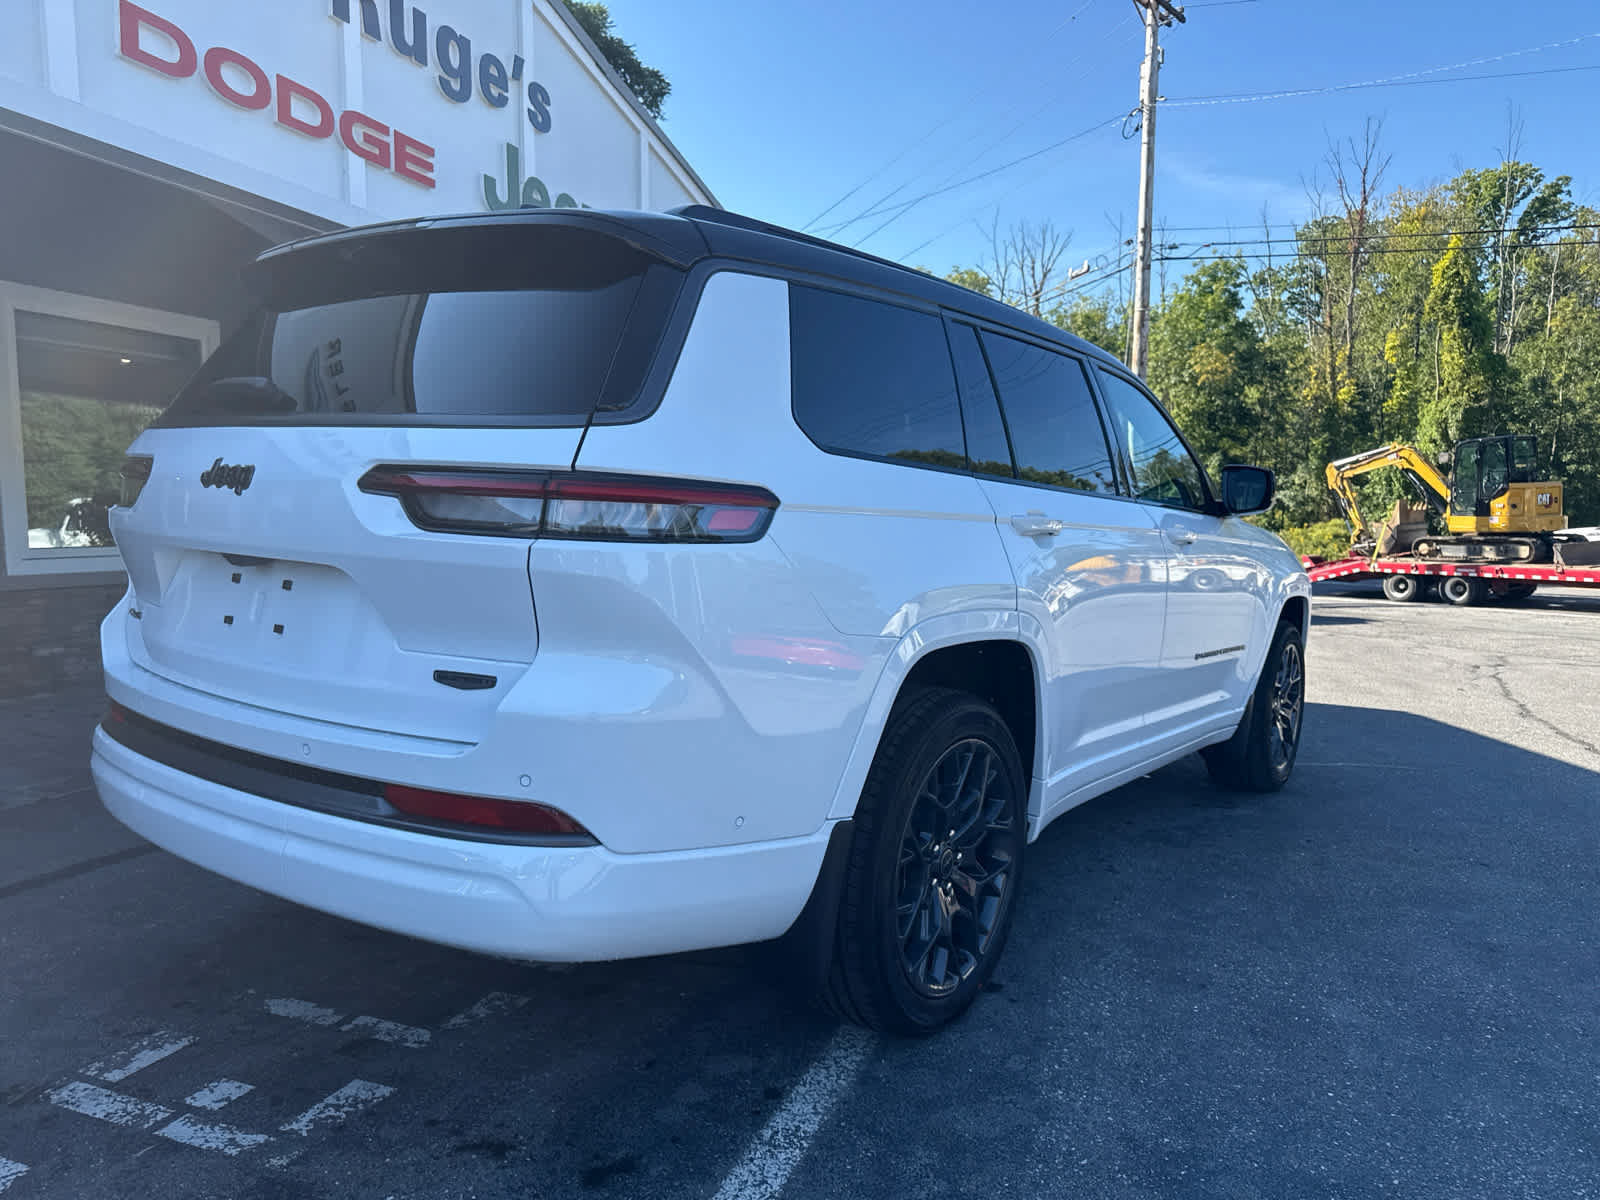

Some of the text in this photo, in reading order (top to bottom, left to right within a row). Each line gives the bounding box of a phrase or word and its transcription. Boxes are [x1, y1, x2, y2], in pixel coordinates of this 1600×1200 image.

[119, 0, 435, 188] DODGE
[200, 457, 255, 496] Jeep
[1537, 493, 1551, 505] CAT
